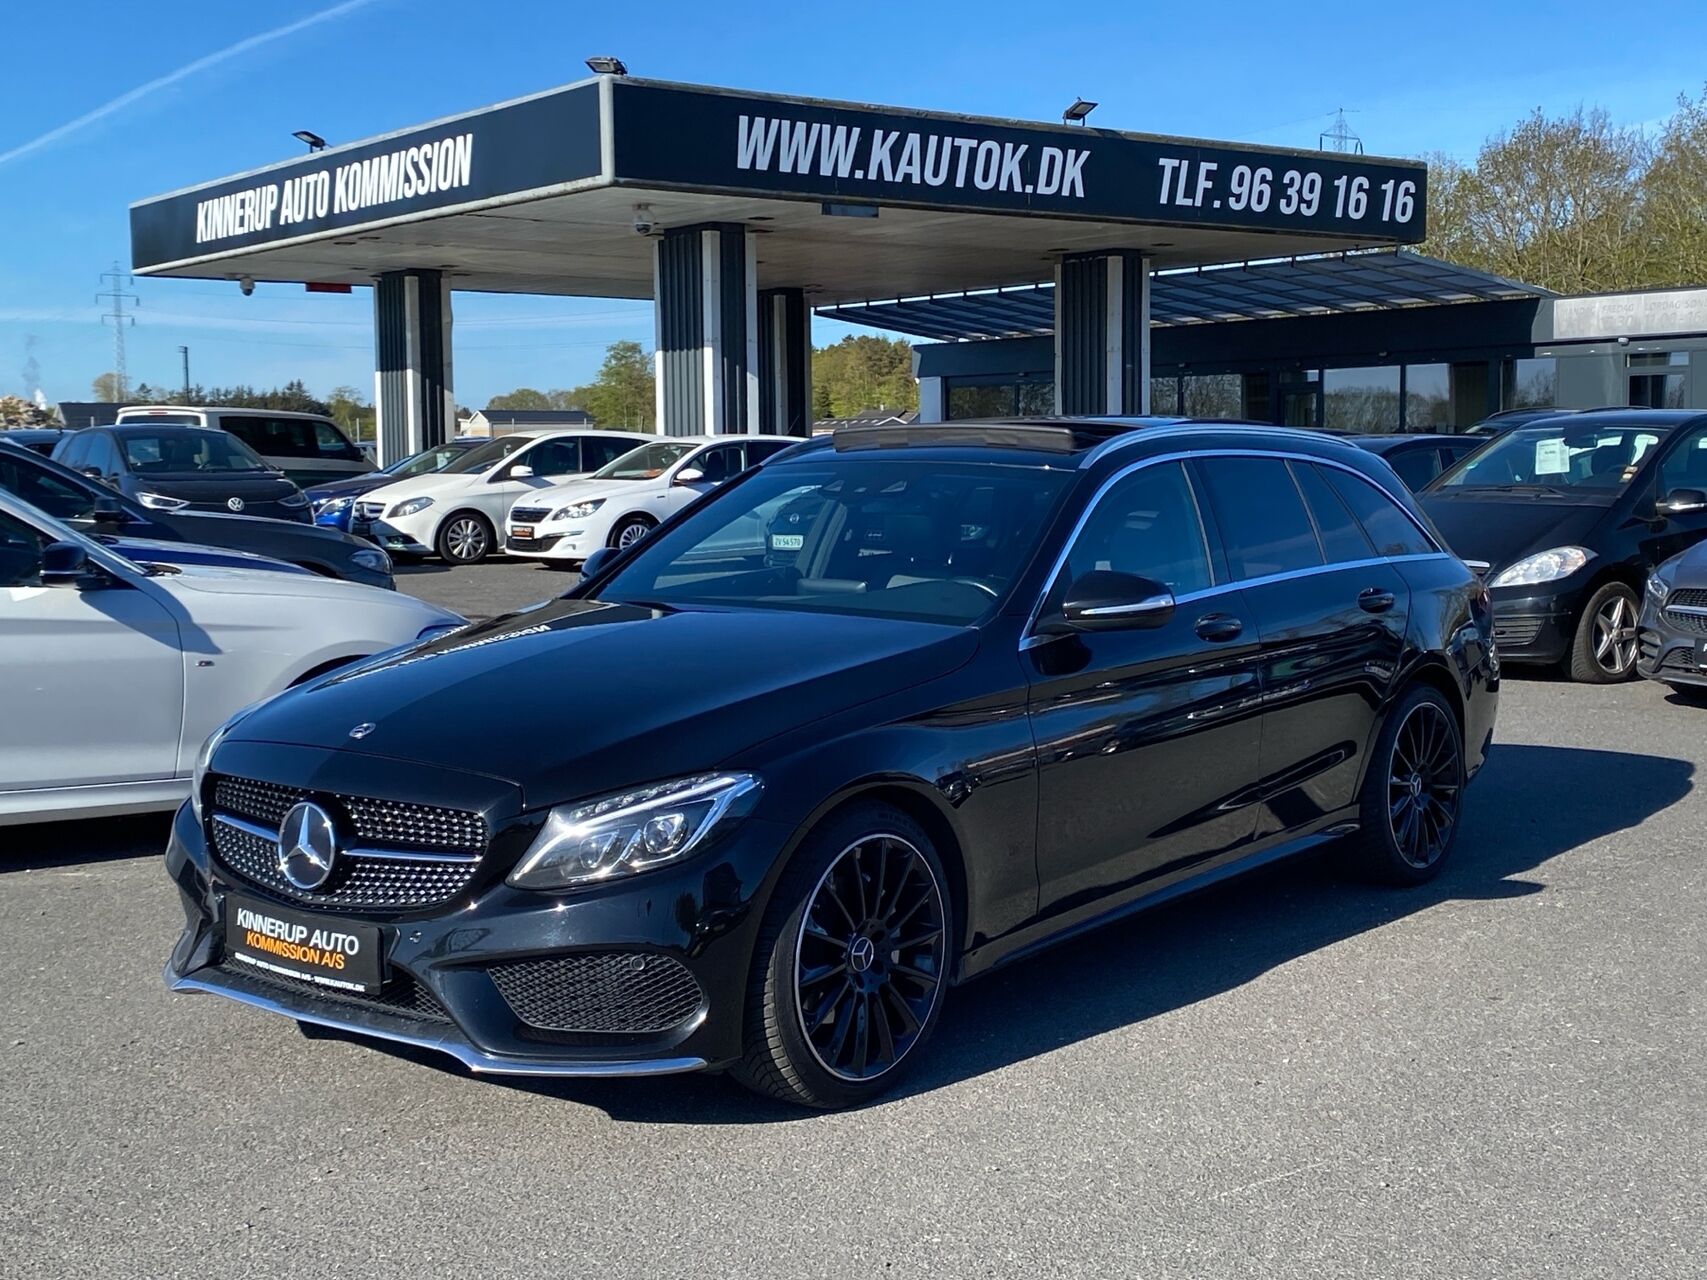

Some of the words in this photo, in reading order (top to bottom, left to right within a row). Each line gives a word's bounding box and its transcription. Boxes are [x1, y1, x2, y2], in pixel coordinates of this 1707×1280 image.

[196, 183, 279, 244] KINNERUP
[280, 170, 330, 226] AUTO
[333, 133, 474, 215] KOMMISSION
[737, 115, 1091, 198] WWW.KAUTOK.DK
[1158, 157, 1221, 208] TLF.
[1229, 165, 1273, 212] 96
[1280, 170, 1322, 217] 39
[1334, 175, 1370, 220] 16
[1381, 179, 1416, 223] 16
[236, 908, 307, 944] KINNERUP
[310, 928, 359, 956] AUTO
[246, 931, 320, 965] KOMMISSION
[321, 950, 345, 970] A/S
